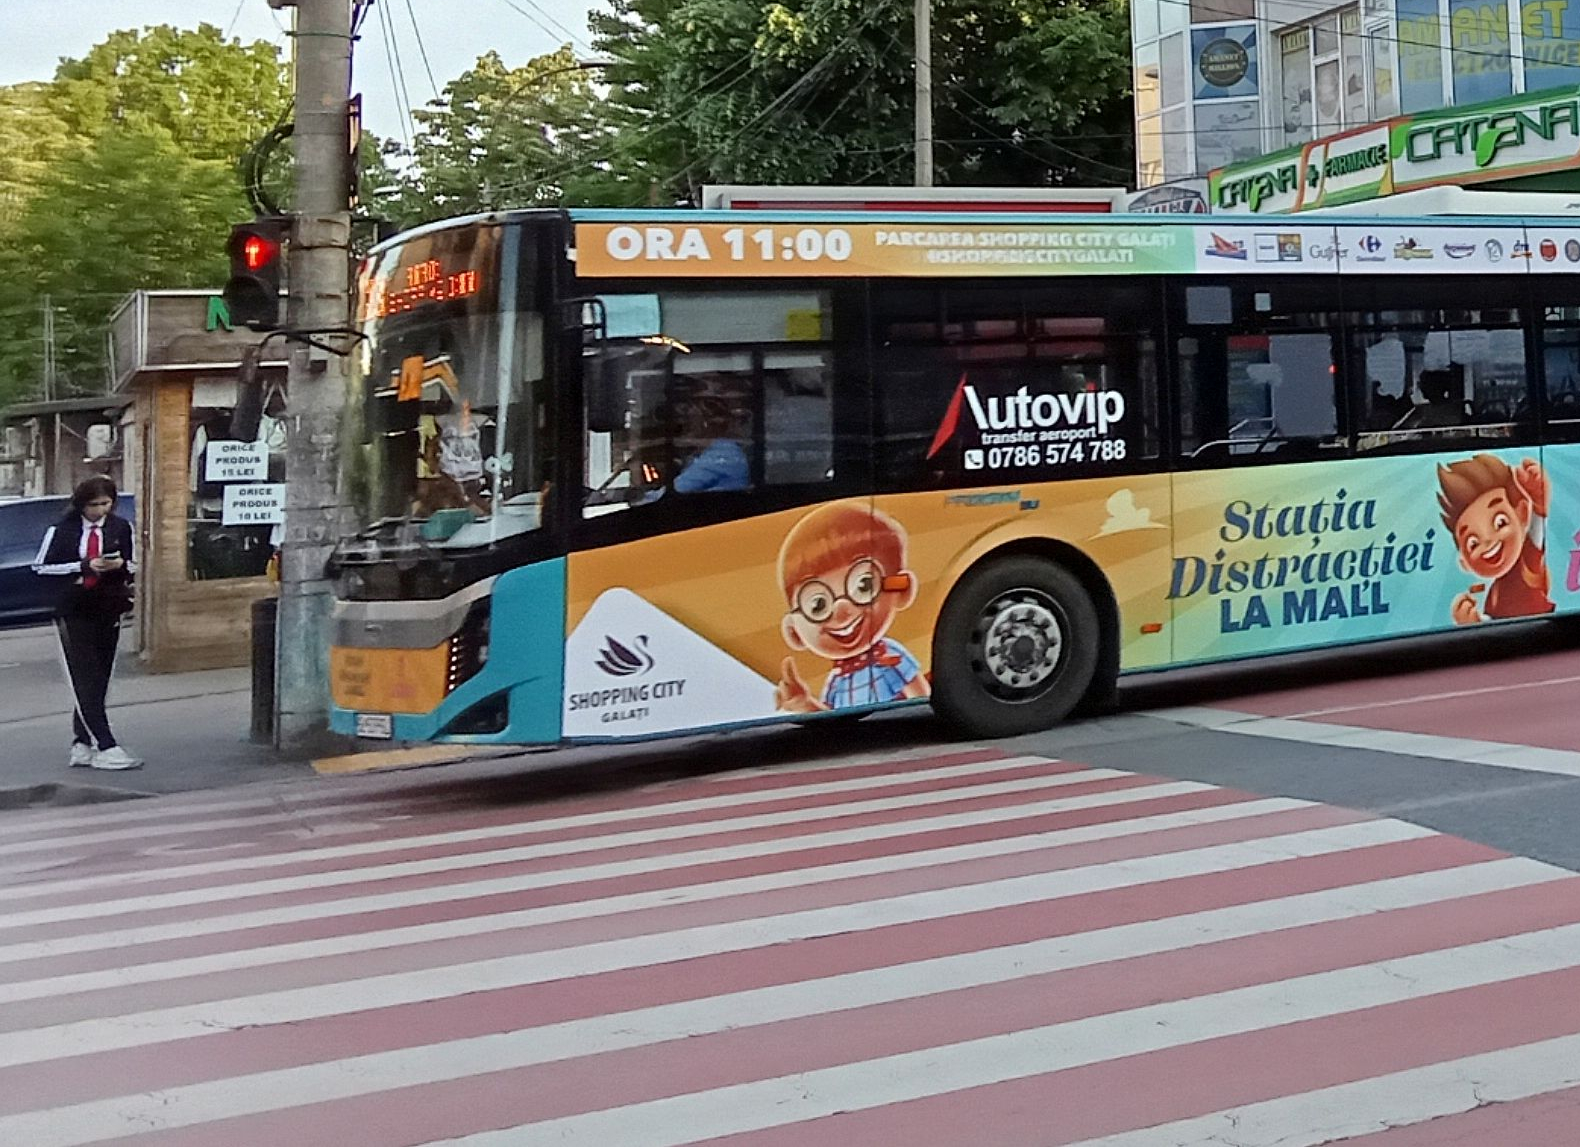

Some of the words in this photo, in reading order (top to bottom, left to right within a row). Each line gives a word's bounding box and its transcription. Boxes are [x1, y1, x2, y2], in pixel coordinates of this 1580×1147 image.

[1406, 100, 1579, 166] CATENA
[1217, 162, 1298, 212] CATENA
[1324, 143, 1389, 179] FARMACIE
[606, 226, 711, 261] ORA
[721, 227, 852, 261] 11:00
[874, 231, 974, 247] PARCAREA
[978, 232, 1072, 247] SHOPPING
[1075, 232, 1113, 247] CITY
[981, 430, 1036, 445] transfer
[1039, 426, 1097, 442] aeroport
[215, 456, 262, 465] PRODUS
[987, 445, 1040, 469] 0786
[1045, 442, 1085, 464] 574
[1088, 439, 1127, 461] 788
[236, 468, 255, 476] LEI
[231, 500, 278, 508] PRODUS
[238, 488, 273, 496] ORICE
[254, 512, 271, 520] LEI
[1219, 487, 1377, 549] Stația
[1164, 527, 1436, 601] Distracției
[1220, 594, 1272, 634] LA
[1282, 580, 1390, 626] MALL
[568, 683, 650, 711] SHOPPING
[653, 678, 687, 700] CITY
